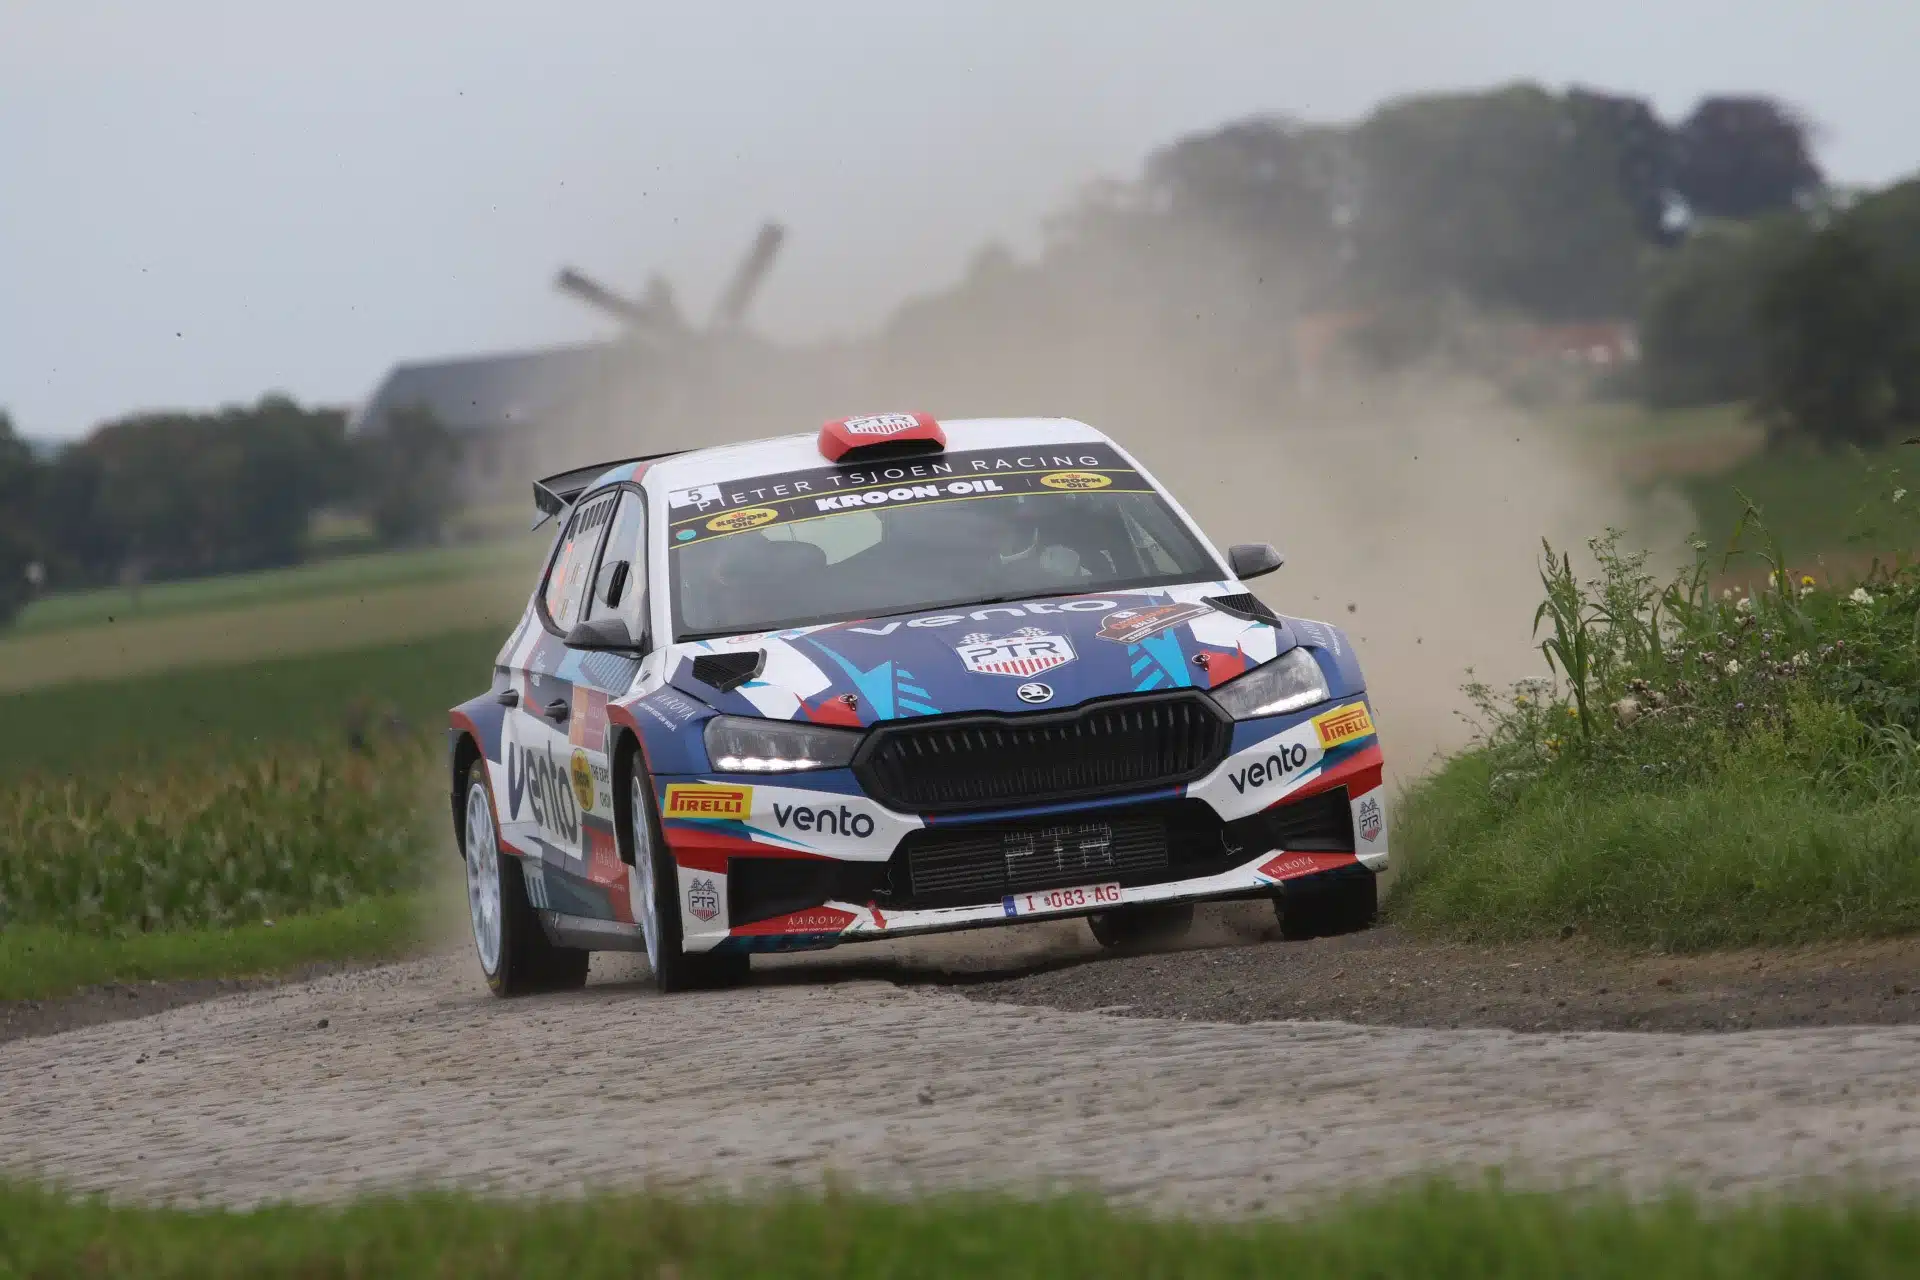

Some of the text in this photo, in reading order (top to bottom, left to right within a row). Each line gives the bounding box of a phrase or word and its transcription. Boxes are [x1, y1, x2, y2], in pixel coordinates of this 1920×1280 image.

[697, 456, 1099, 512] PIETER TSJOEN RACING
[1050, 477, 1102, 485] KROON
[1066, 481, 1089, 489] OIL
[687, 489, 703, 501] 5
[815, 479, 1004, 512] KROON-OIL
[716, 511, 768, 528] KROON
[731, 518, 756, 529] OIL
[846, 600, 1118, 637] vento
[966, 640, 1061, 663] PTR
[1319, 710, 1370, 743] PIRELLI
[1228, 743, 1308, 795] vento
[508, 740, 578, 845] vento
[670, 791, 744, 814] PIRELLI
[773, 803, 875, 838] vento
[1361, 814, 1380, 834] PTR
[1004, 823, 1113, 878] PTR
[691, 895, 717, 910] PTR
[787, 915, 846, 926] AAROVA
